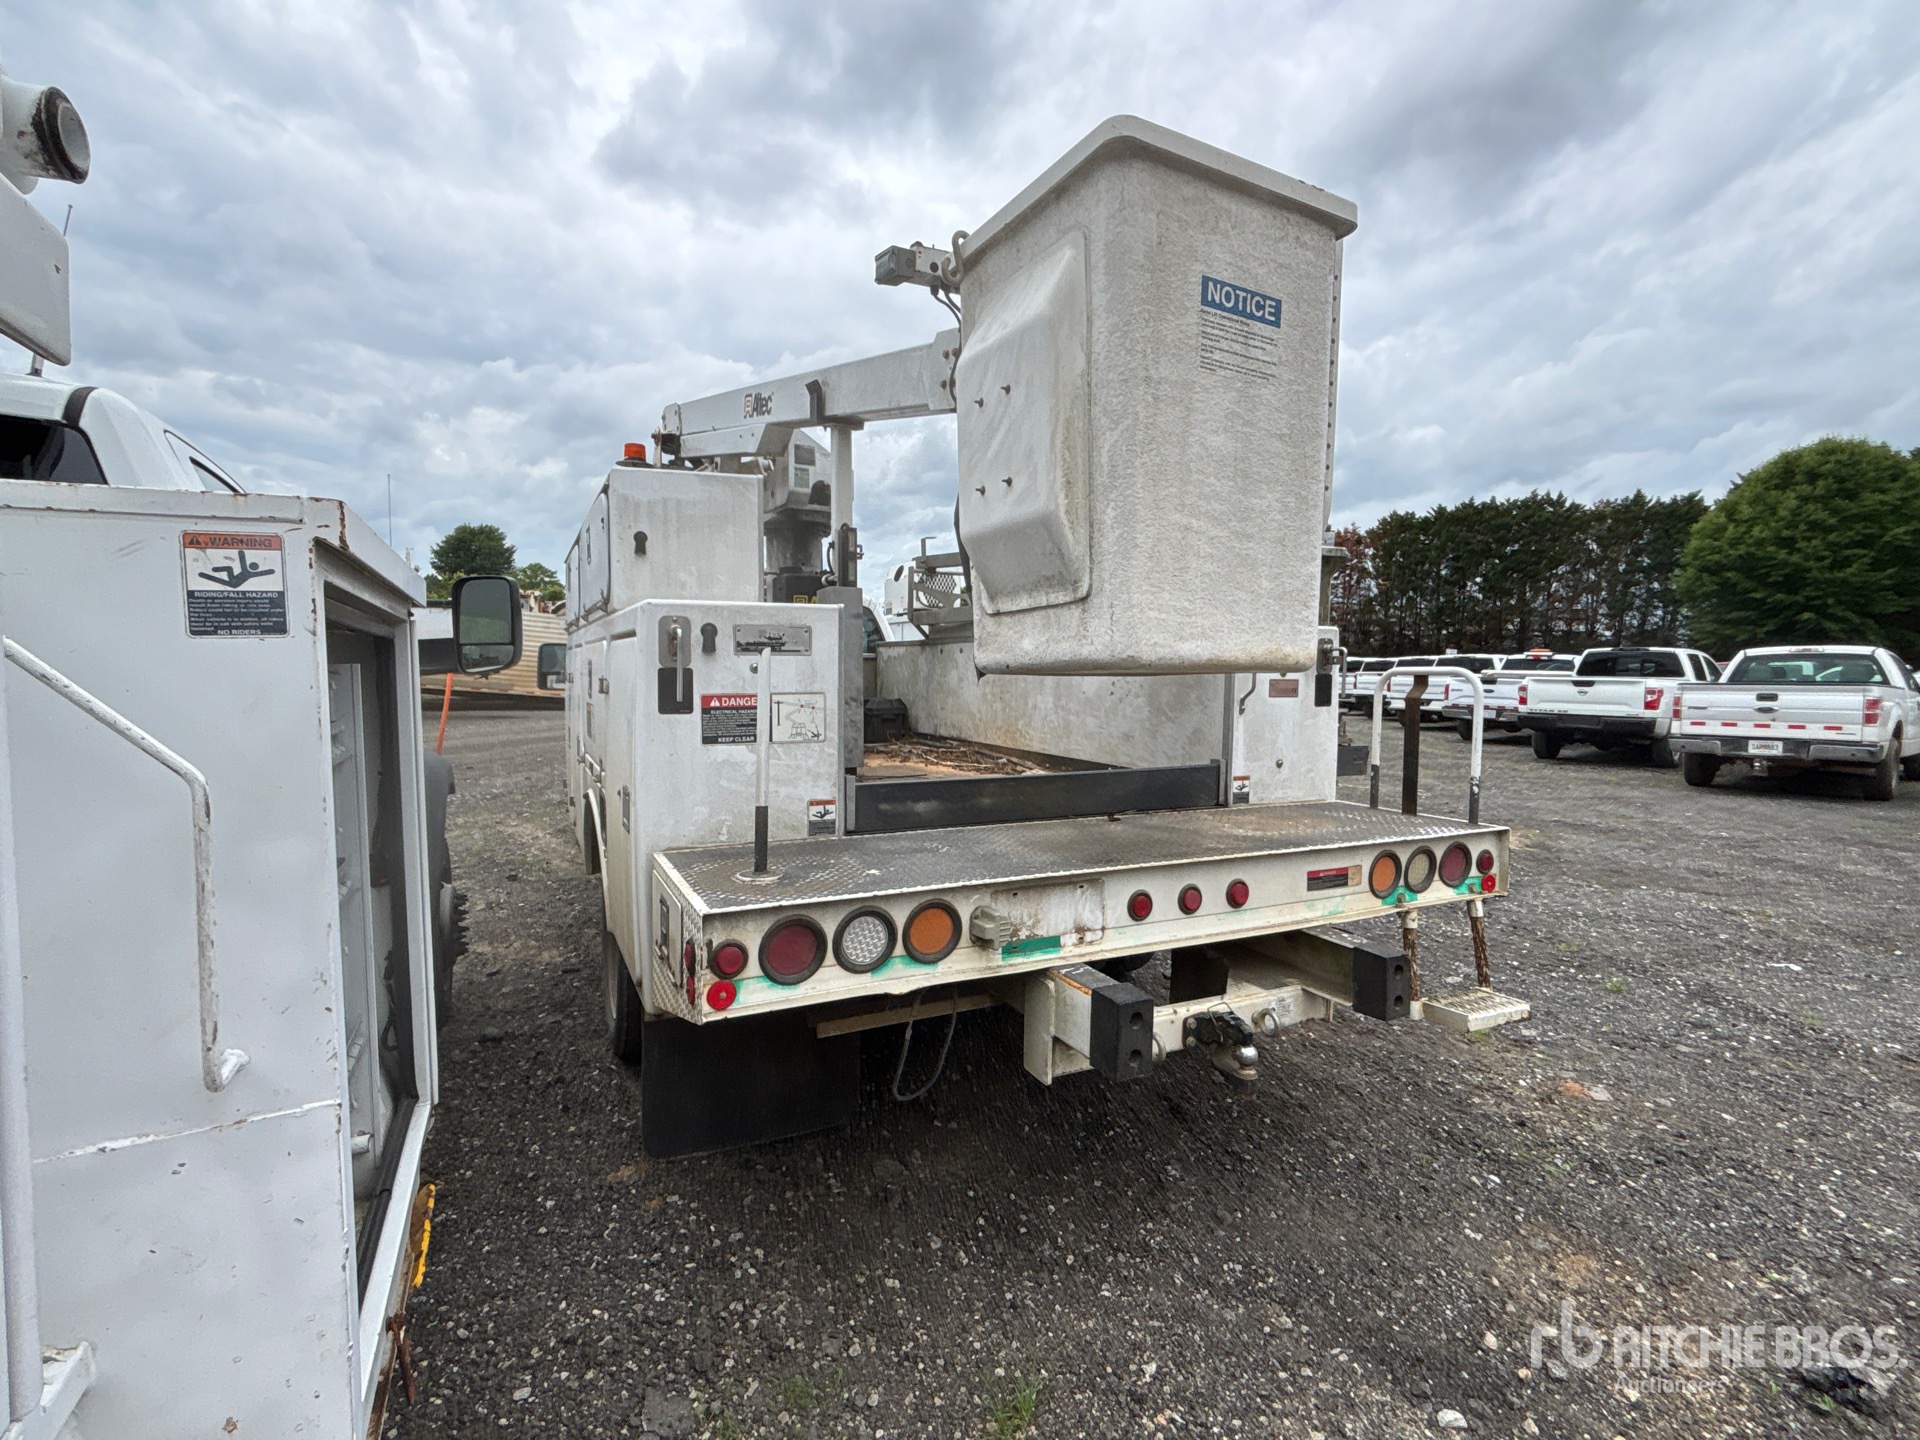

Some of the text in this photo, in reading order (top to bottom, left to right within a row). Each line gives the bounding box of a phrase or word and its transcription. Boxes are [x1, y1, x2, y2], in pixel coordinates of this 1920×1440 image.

[1207, 281, 1276, 320] NOTICE
[753, 392, 773, 417] Altec
[208, 537, 272, 547] WARNING
[721, 697, 758, 706] DANGE
